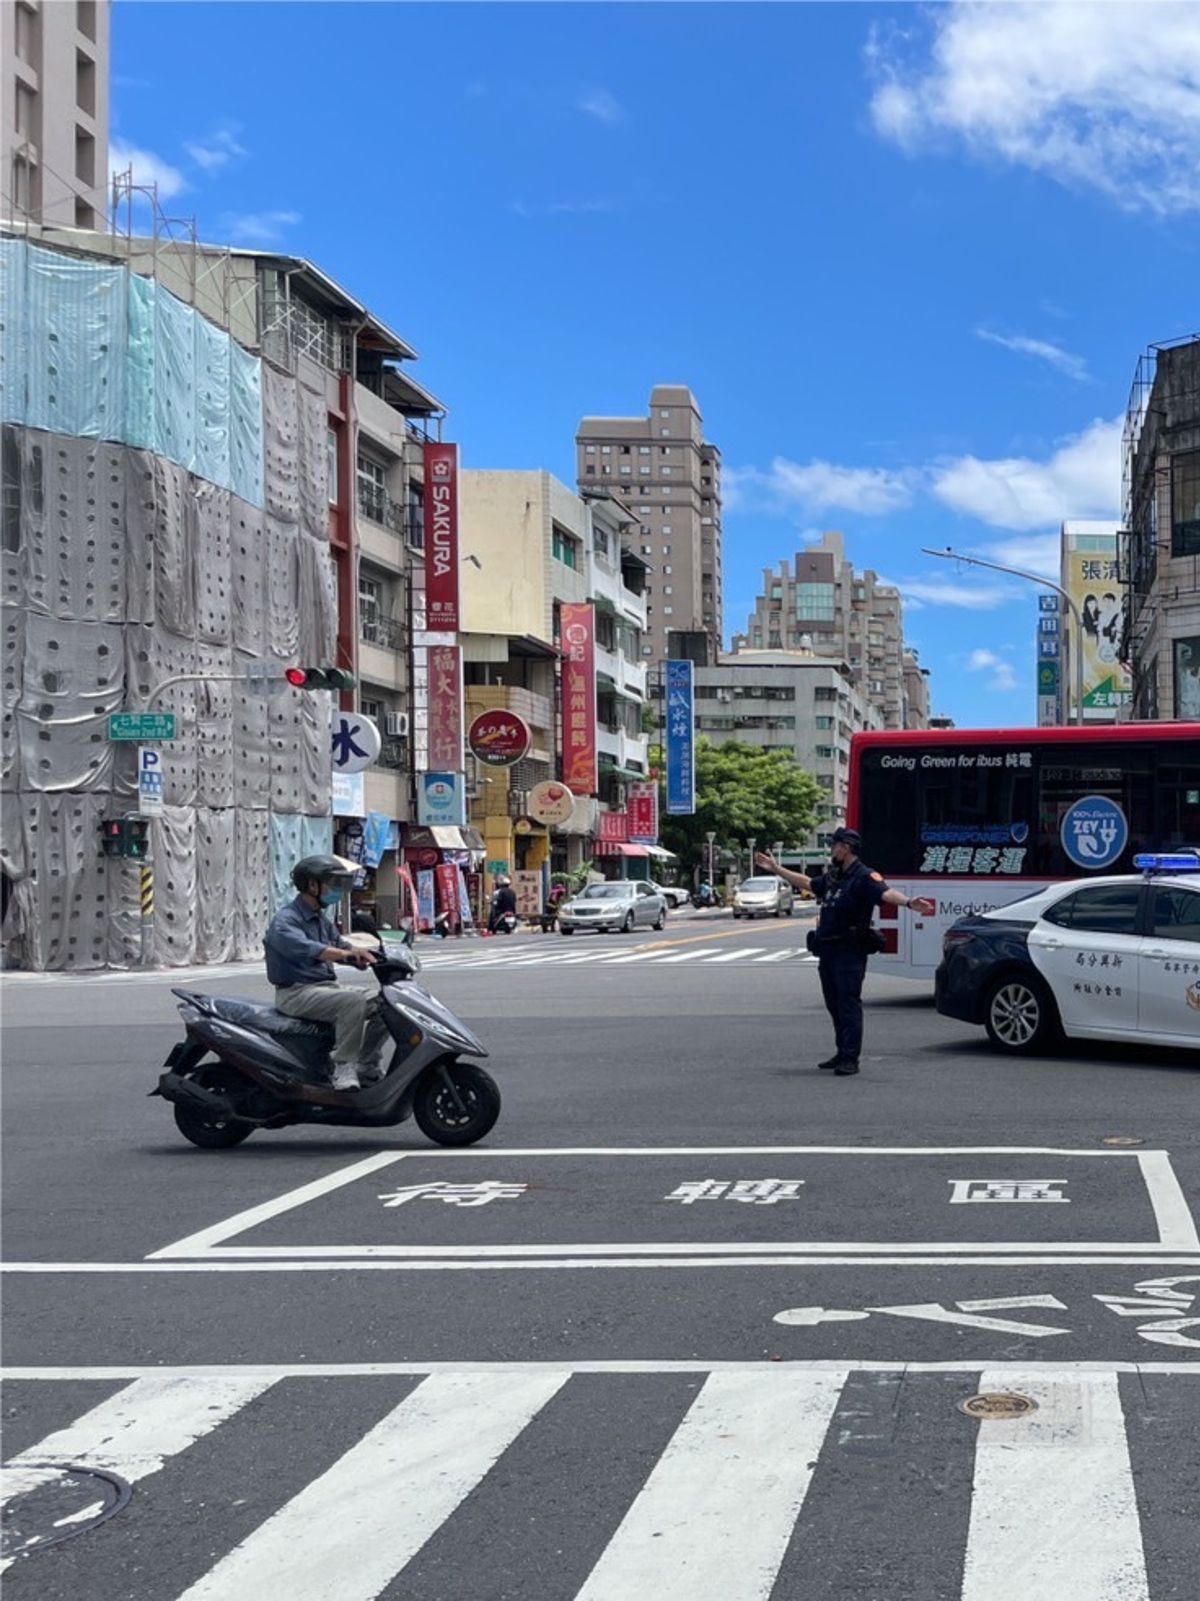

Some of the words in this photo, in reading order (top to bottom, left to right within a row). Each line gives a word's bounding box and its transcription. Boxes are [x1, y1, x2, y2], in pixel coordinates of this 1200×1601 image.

[433, 486, 450, 576] SAKURA
[143, 751, 159, 769] P
[881, 755, 916, 770] Going
[921, 755, 956, 768] Green
[958, 754, 976, 767] for
[977, 754, 1003, 767] ibus
[1073, 820, 1099, 834] ZEV
[920, 846, 1027, 873] 漢程客運
[378, 1179, 1071, 1207] 待轉區
